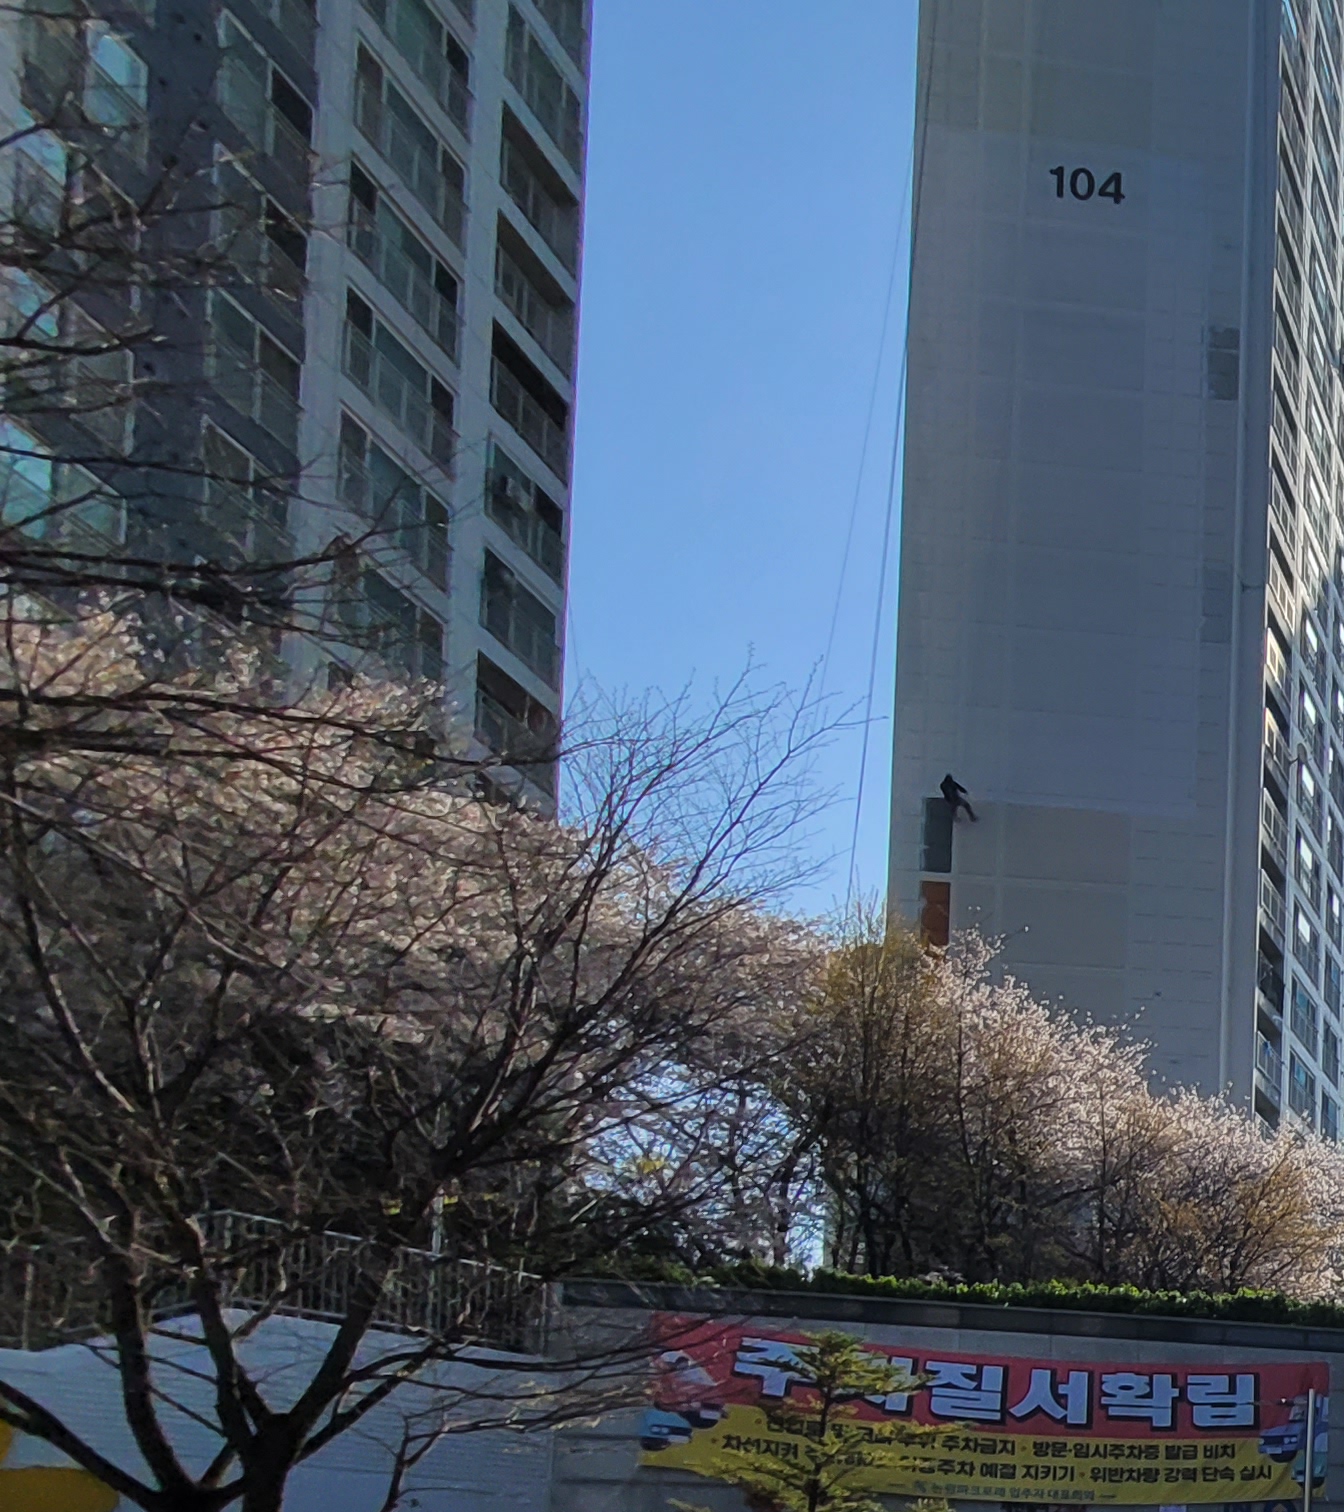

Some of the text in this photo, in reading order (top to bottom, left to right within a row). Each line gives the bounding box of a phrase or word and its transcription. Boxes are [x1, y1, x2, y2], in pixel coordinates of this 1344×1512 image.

[1049, 166, 1125, 204] 104
[942, 1435, 1016, 1455] 주차금지
[1165, 1444, 1198, 1460] 발급
[1203, 1443, 1236, 1459] 비치
[980, 1462, 1017, 1480] 예절
[1021, 1464, 1075, 1481] 지키기
[1090, 1466, 1161, 1483] 위반차량
[1163, 1468, 1198, 1484] 강력
[1202, 1465, 1236, 1482] 단속
[1239, 1464, 1272, 1481] 실시
